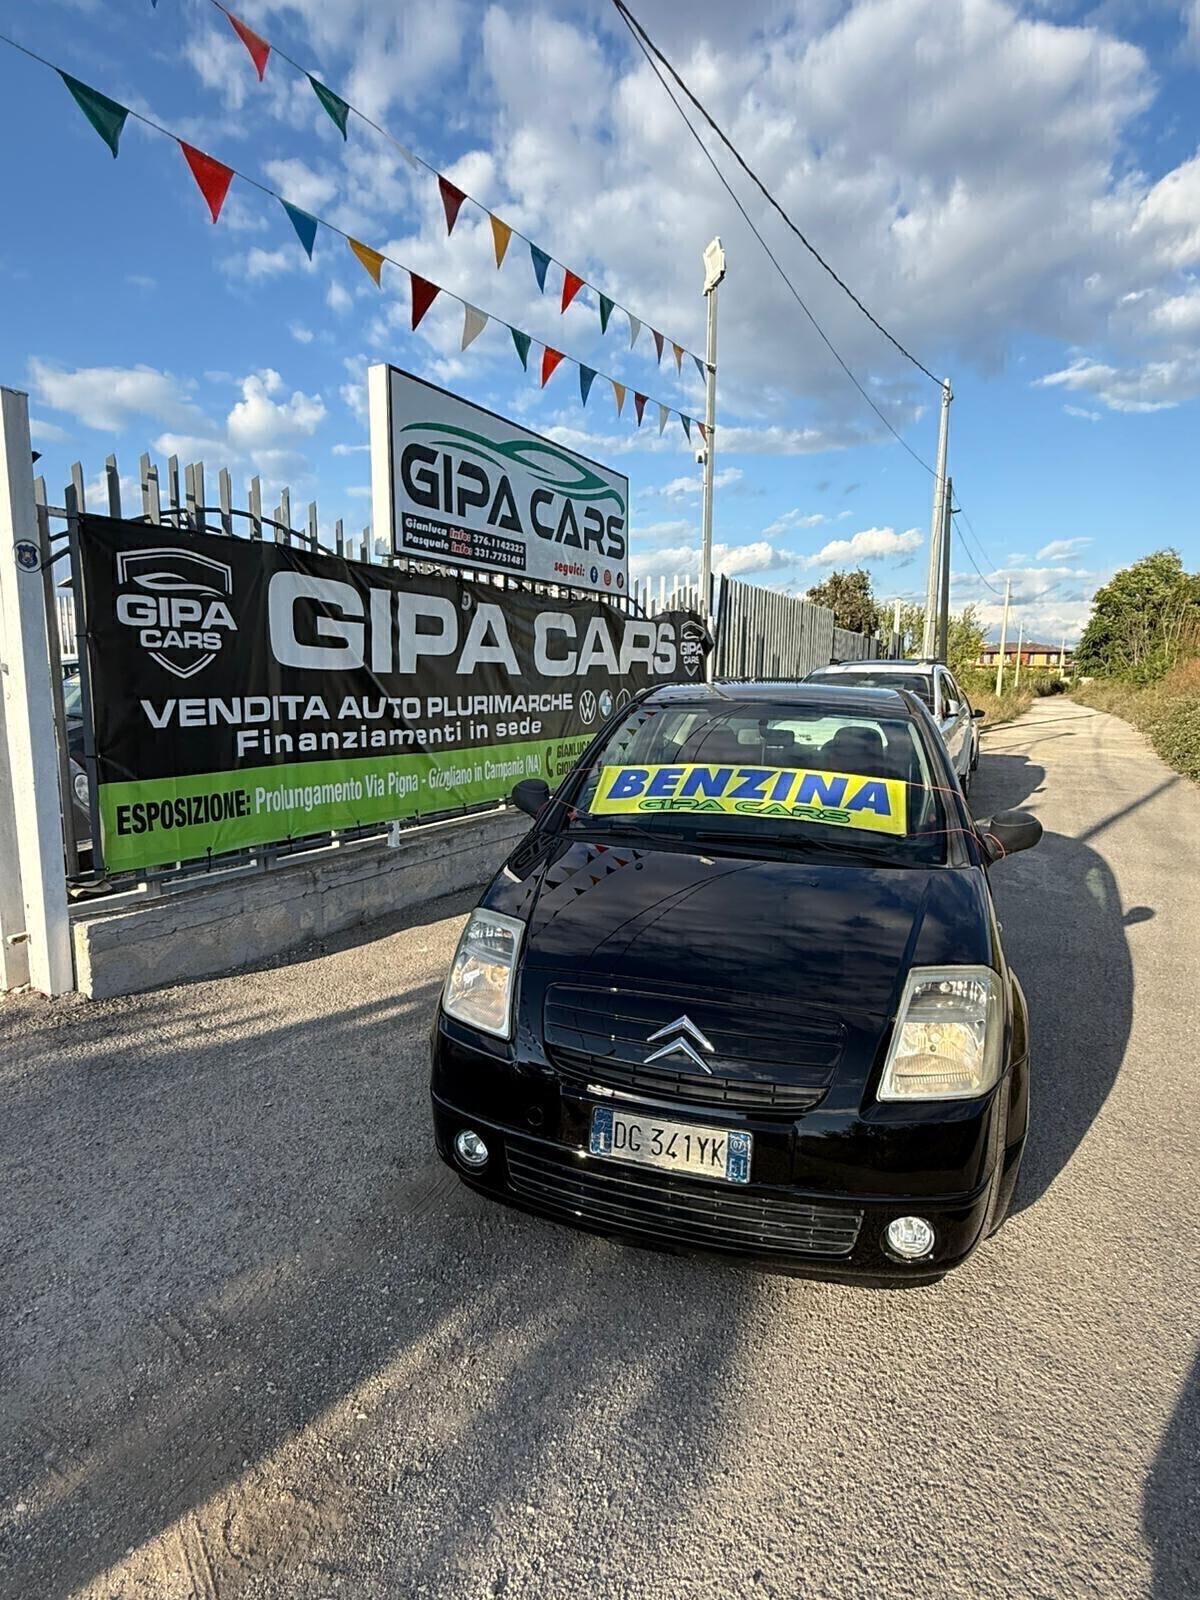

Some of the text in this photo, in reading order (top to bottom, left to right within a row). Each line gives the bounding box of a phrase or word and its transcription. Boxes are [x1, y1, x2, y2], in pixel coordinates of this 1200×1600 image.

[401, 443, 625, 560] GIPA CARS
[405, 518, 524, 554] Gianluca Info: 376.1142322
[405, 532, 525, 566] Pasquale Info: 331.7751481
[554, 562, 585, 576] seguici:
[116, 594, 238, 631] GIPA
[268, 571, 677, 677] GIPA CARS
[140, 630, 223, 649] CARS
[680, 641, 704, 656] GIPA
[141, 694, 574, 728] VENDITA AUTO PLURIMARCHE
[236, 717, 542, 757] Finanziamenti in sede
[116, 789, 251, 836] ESPOSIZIONE:
[255, 778, 363, 815] Prolungamento
[365, 775, 385, 798] Via
[388, 771, 418, 798] Pigna
[474, 763, 484, 781] in
[484, 757, 524, 782] Campania
[525, 754, 541, 776] (NA)
[606, 767, 891, 817] BENZINA
[637, 798, 851, 824] GIPA CARS
[614, 1121, 725, 1169] DG 341YK
[733, 1140, 743, 1149] 07
